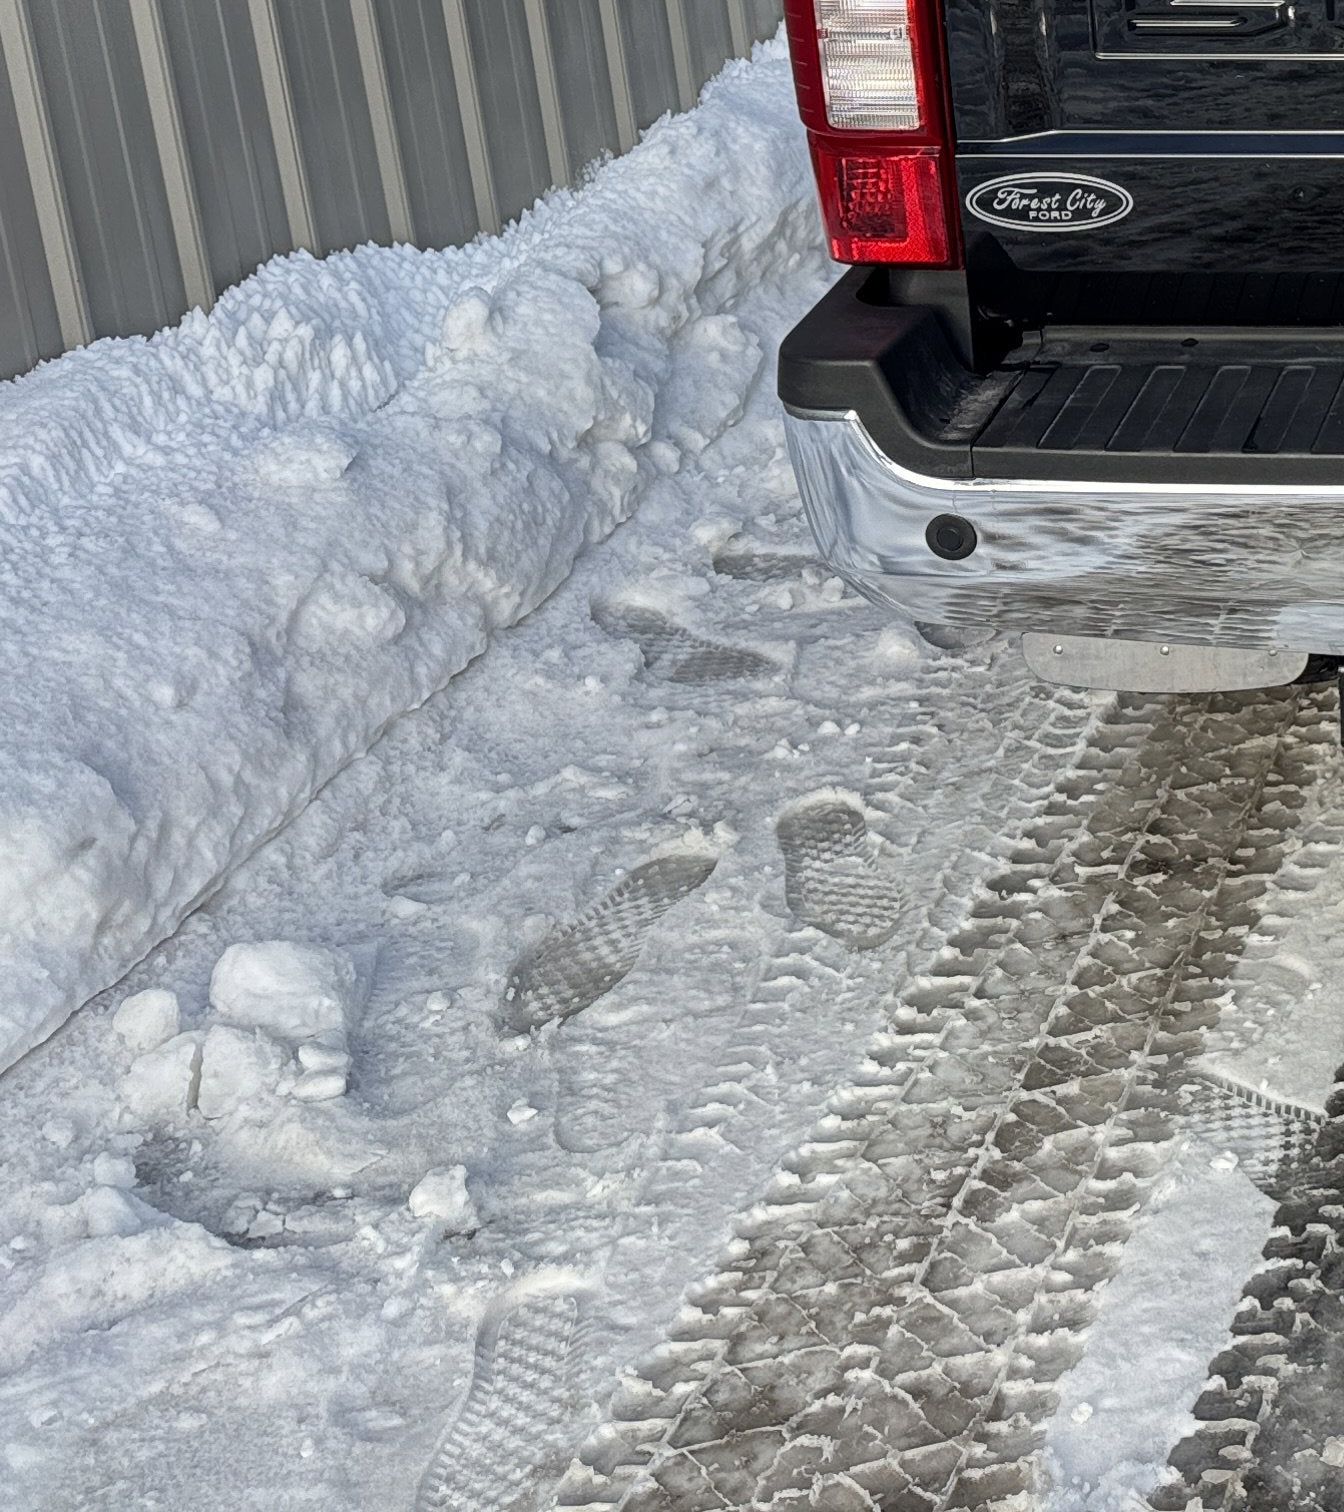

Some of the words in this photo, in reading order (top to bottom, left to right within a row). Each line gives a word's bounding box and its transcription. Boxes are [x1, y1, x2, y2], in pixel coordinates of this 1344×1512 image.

[992, 187, 1061, 211] Forest
[1066, 188, 1107, 218] City
[1028, 210, 1073, 220] FORD
